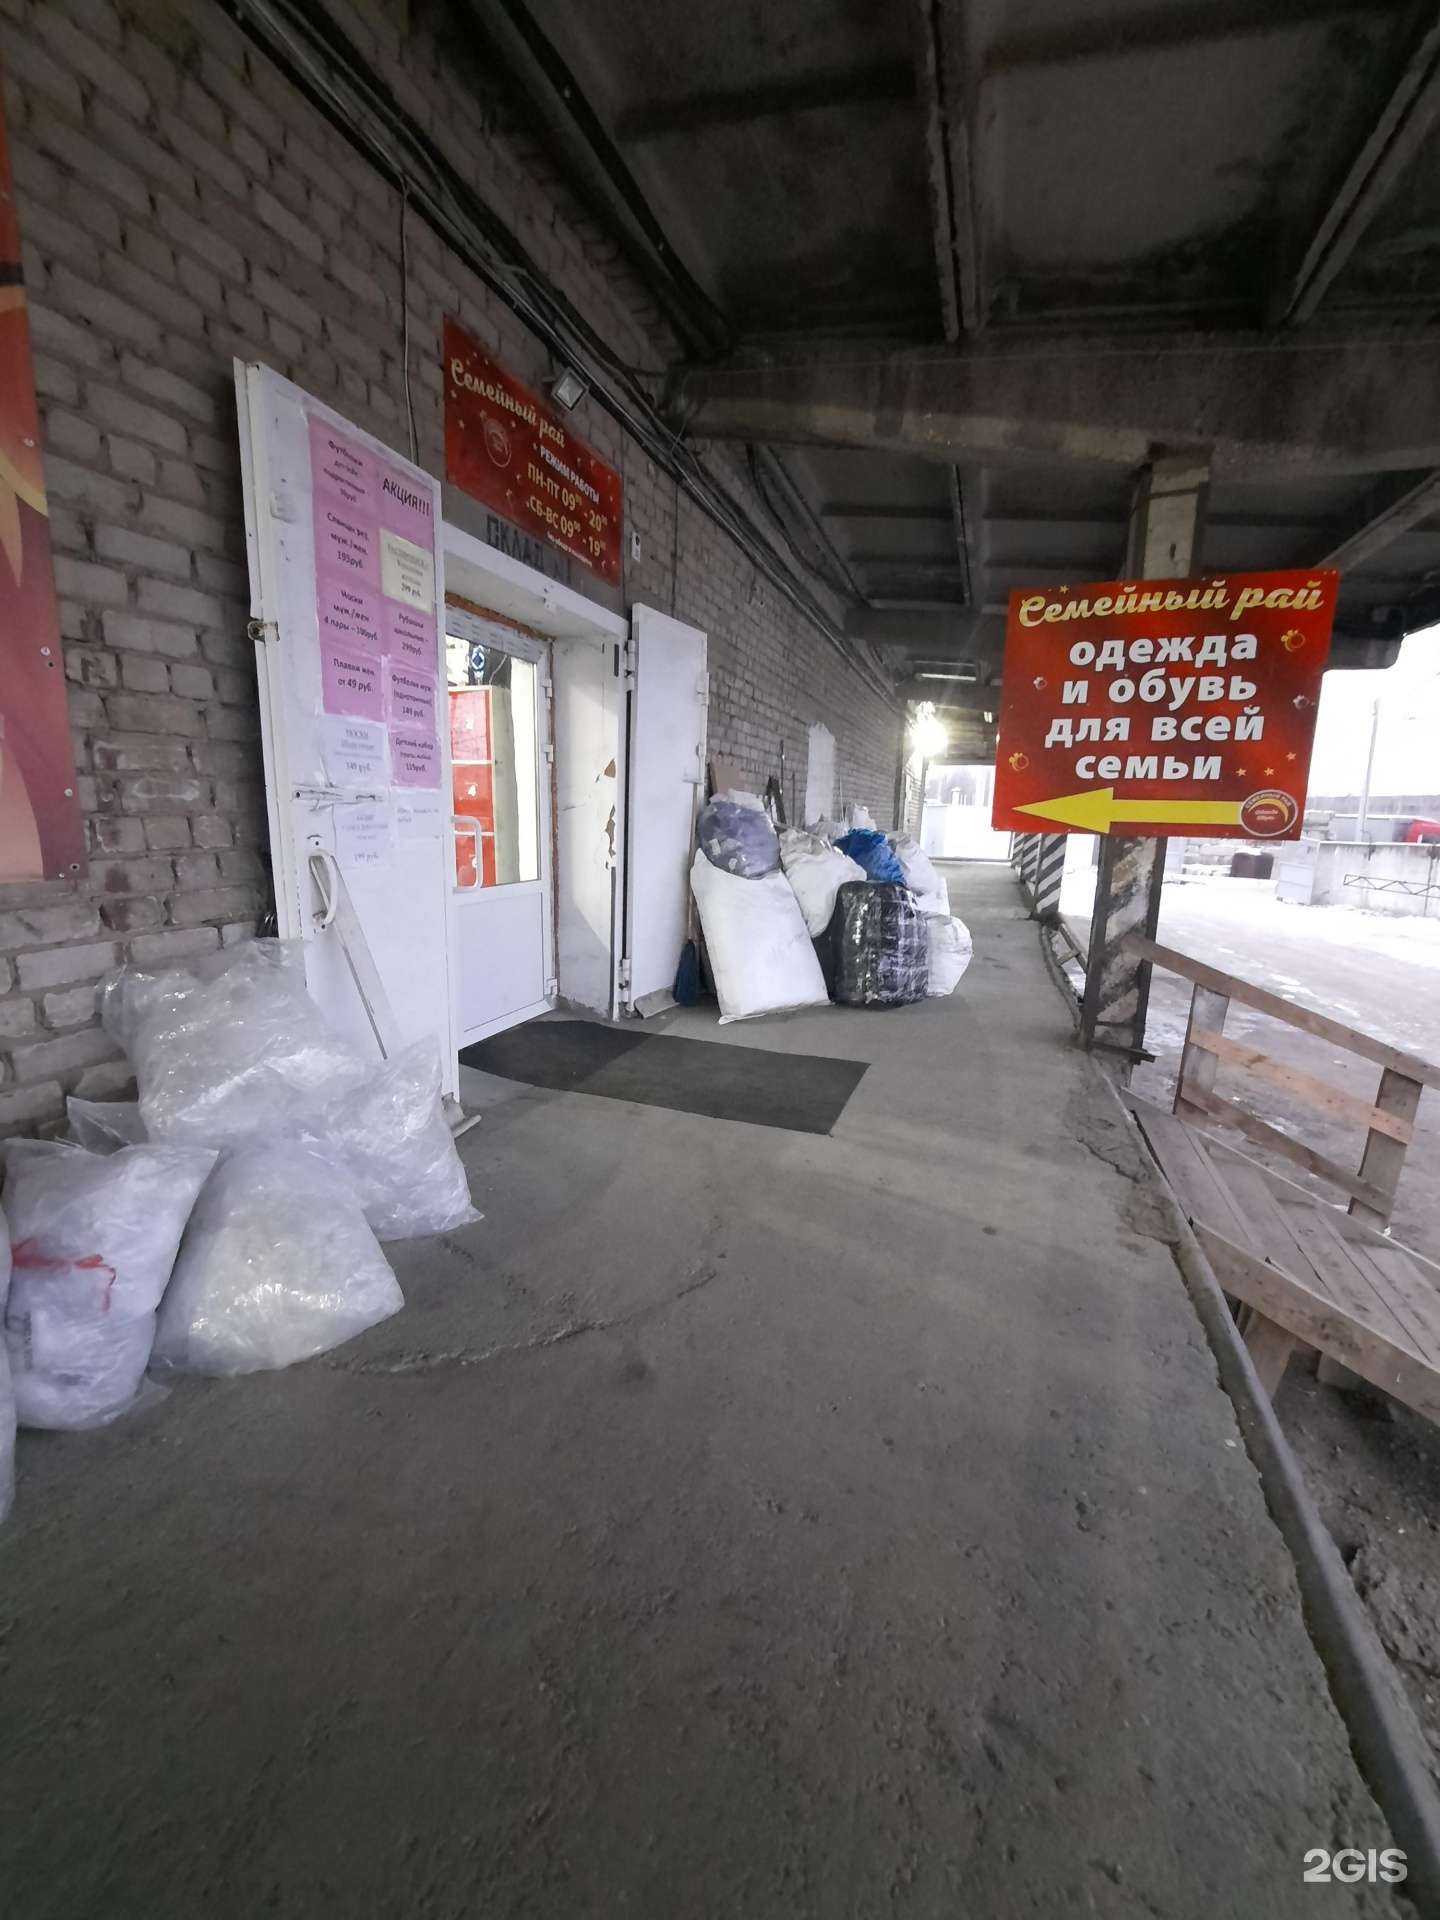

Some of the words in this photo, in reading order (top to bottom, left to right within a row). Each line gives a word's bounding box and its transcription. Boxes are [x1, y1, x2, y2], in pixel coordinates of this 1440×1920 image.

[451, 357, 538, 427] Семейный
[539, 417, 566, 448] рай
[528, 462, 560, 499] ПН-ПТ
[540, 445, 570, 479] РЕЖИМ
[570, 472, 599, 504] РАБОТЫ
[383, 478, 430, 517] АКЦИЯ!!!
[529, 496, 559, 529] СБ-ВС
[1018, 580, 1230, 627] Семейный
[1230, 580, 1324, 621] рай
[330, 619, 350, 632] пары
[1069, 633, 1258, 671] одежда
[347, 678, 357, 689] 49
[1062, 680, 1089, 704] и
[1108, 667, 1257, 710] обувь
[1044, 717, 1131, 748] для
[1151, 706, 1265, 741] всей
[1075, 755, 1222, 780] семьи
